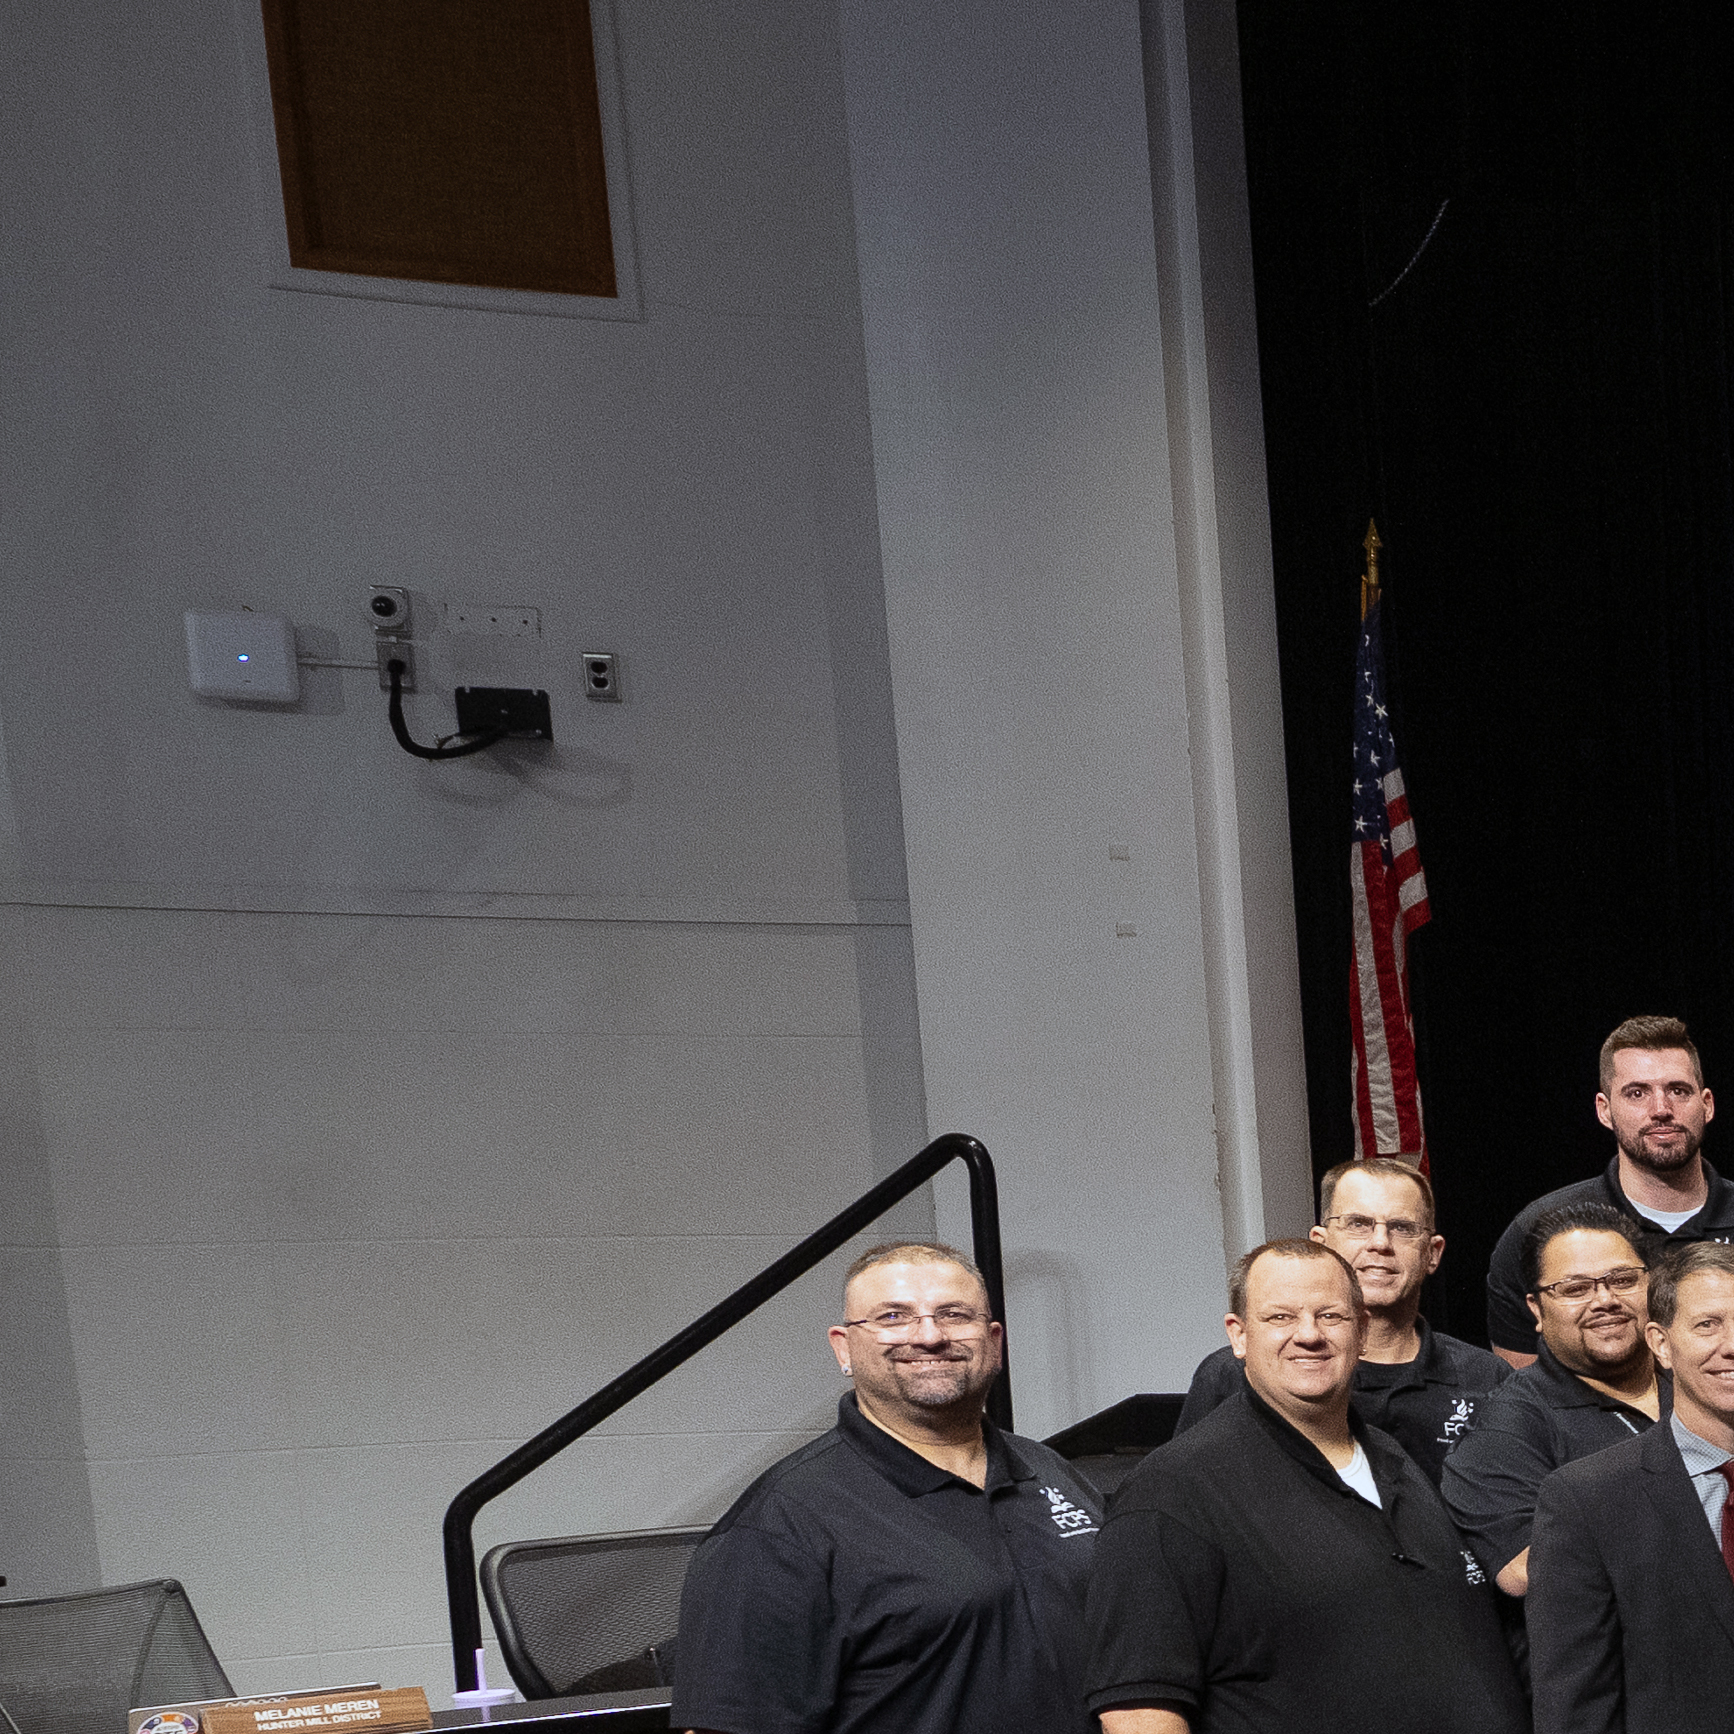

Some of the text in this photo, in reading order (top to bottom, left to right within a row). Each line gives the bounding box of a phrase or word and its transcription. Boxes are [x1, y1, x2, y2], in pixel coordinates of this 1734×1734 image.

[1443, 1421, 1465, 1436] FC
[1051, 1509, 1092, 1530] FCPS
[254, 1699, 379, 1722] MELANIE MEREN
[257, 1710, 382, 1732] HUNTER MILL DISTRICT
